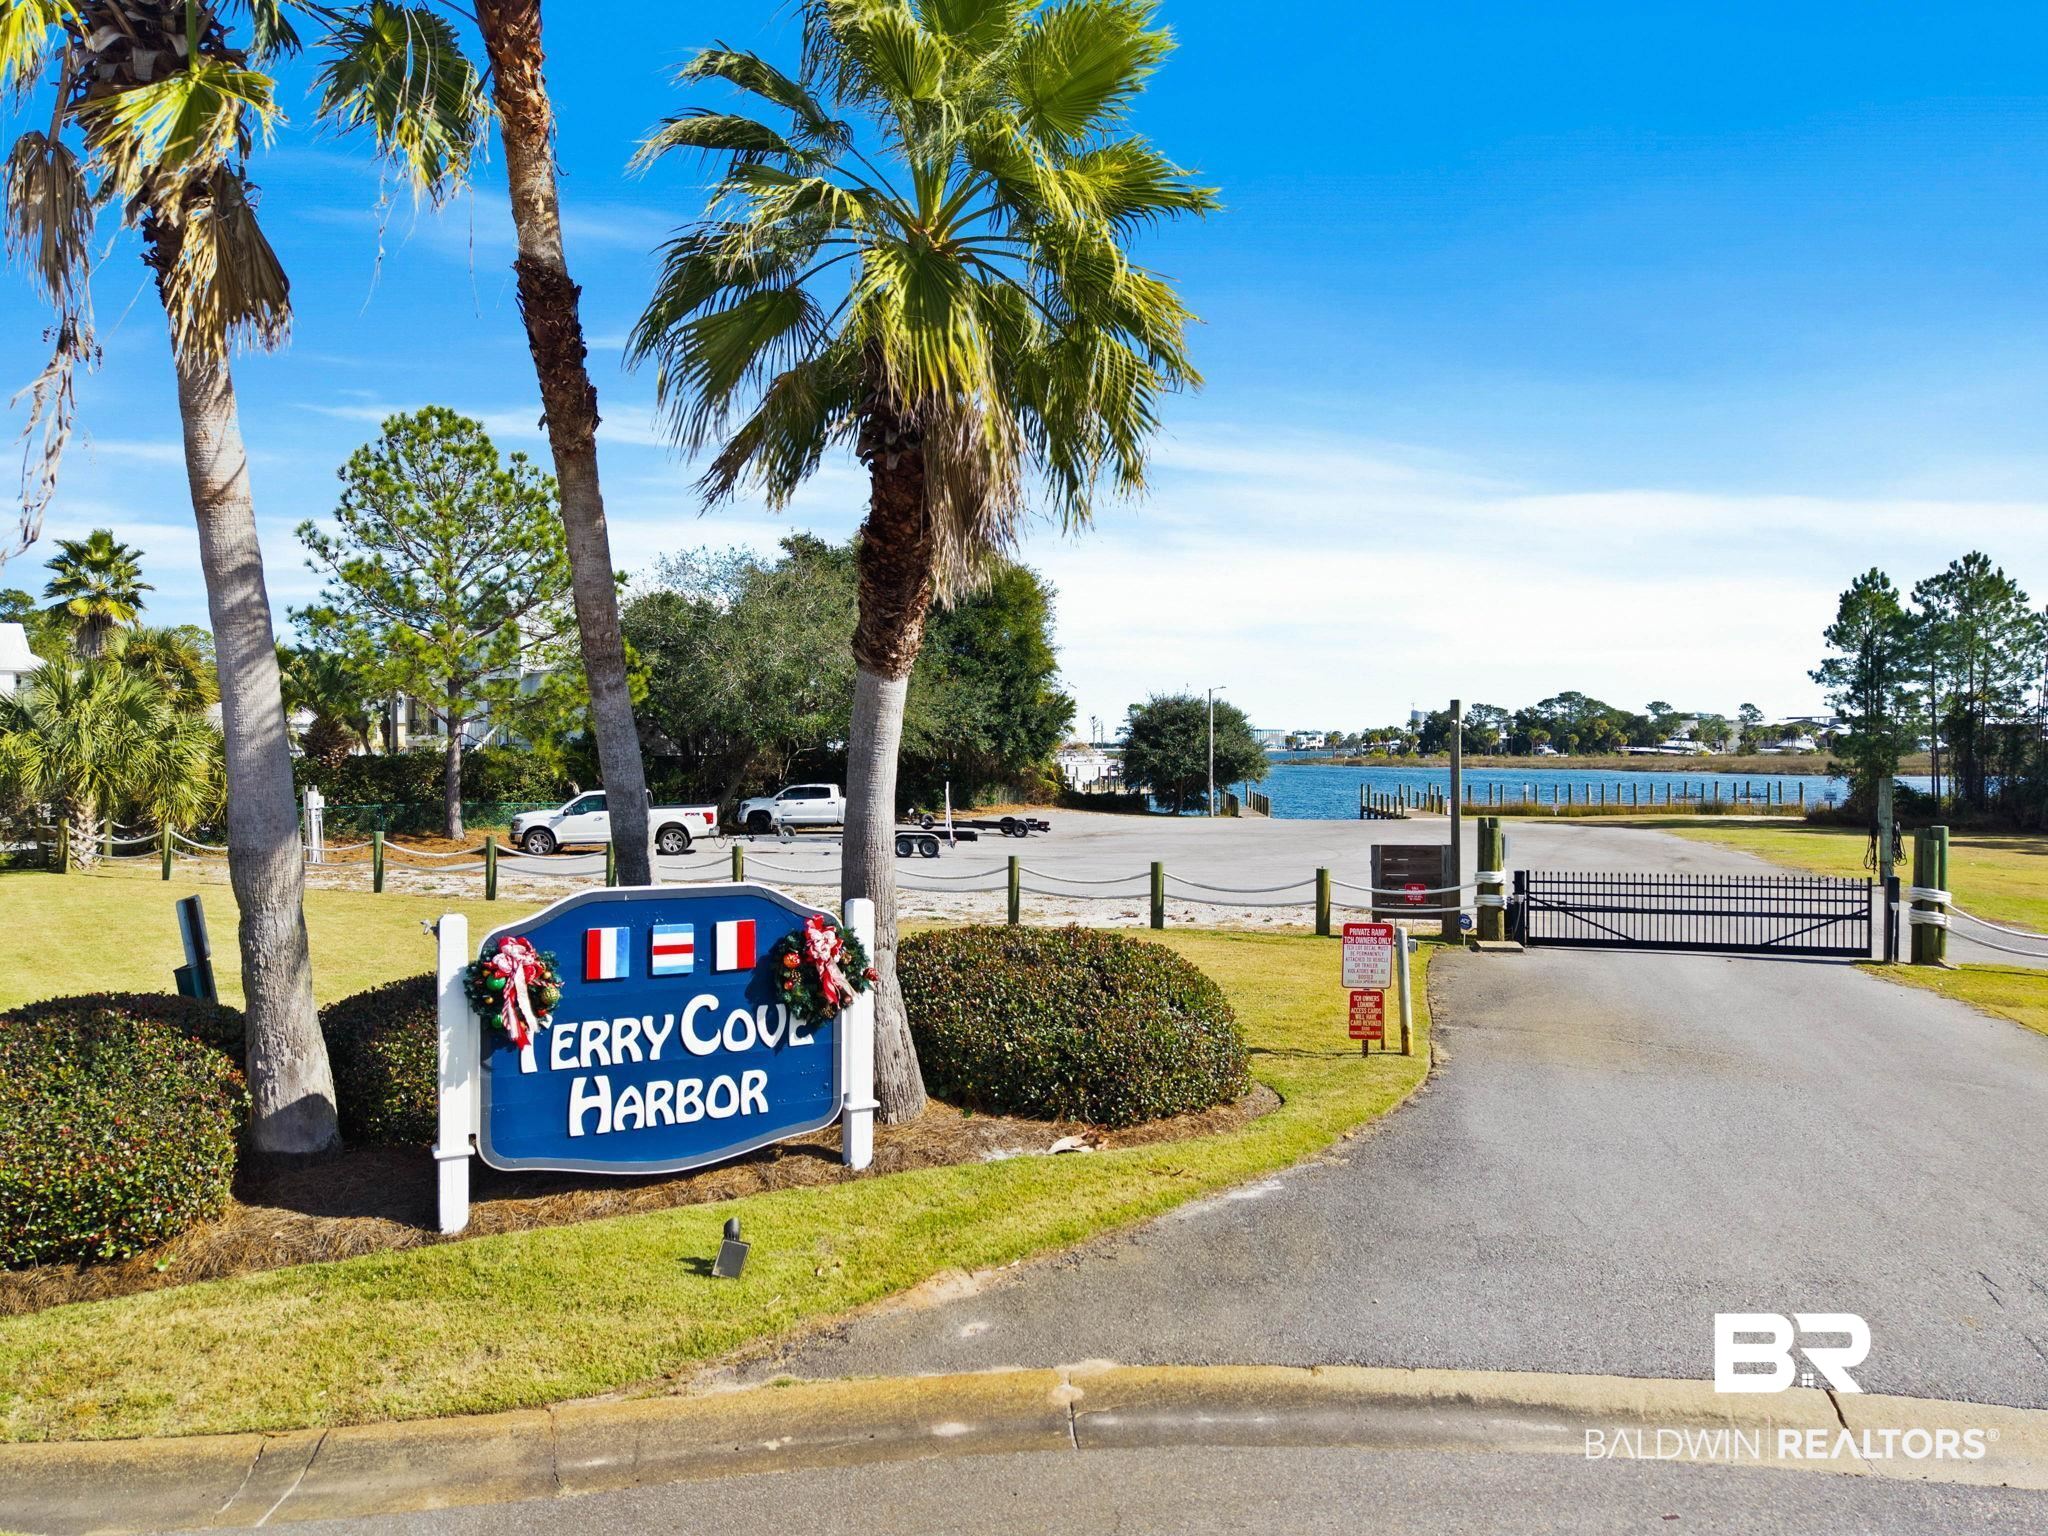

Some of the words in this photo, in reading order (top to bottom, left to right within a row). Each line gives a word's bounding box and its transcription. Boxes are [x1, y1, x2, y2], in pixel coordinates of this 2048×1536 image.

[1344, 936, 1355, 944] TCH
[1355, 937, 1377, 945] OWNERS
[1378, 937, 1392, 945] ONLY
[1349, 928, 1371, 936] PRIVATE
[1371, 928, 1387, 937] RAMP
[520, 1013, 674, 1074] TERRY
[681, 994, 815, 1055] COVE
[569, 1069, 769, 1137] HARBOR
